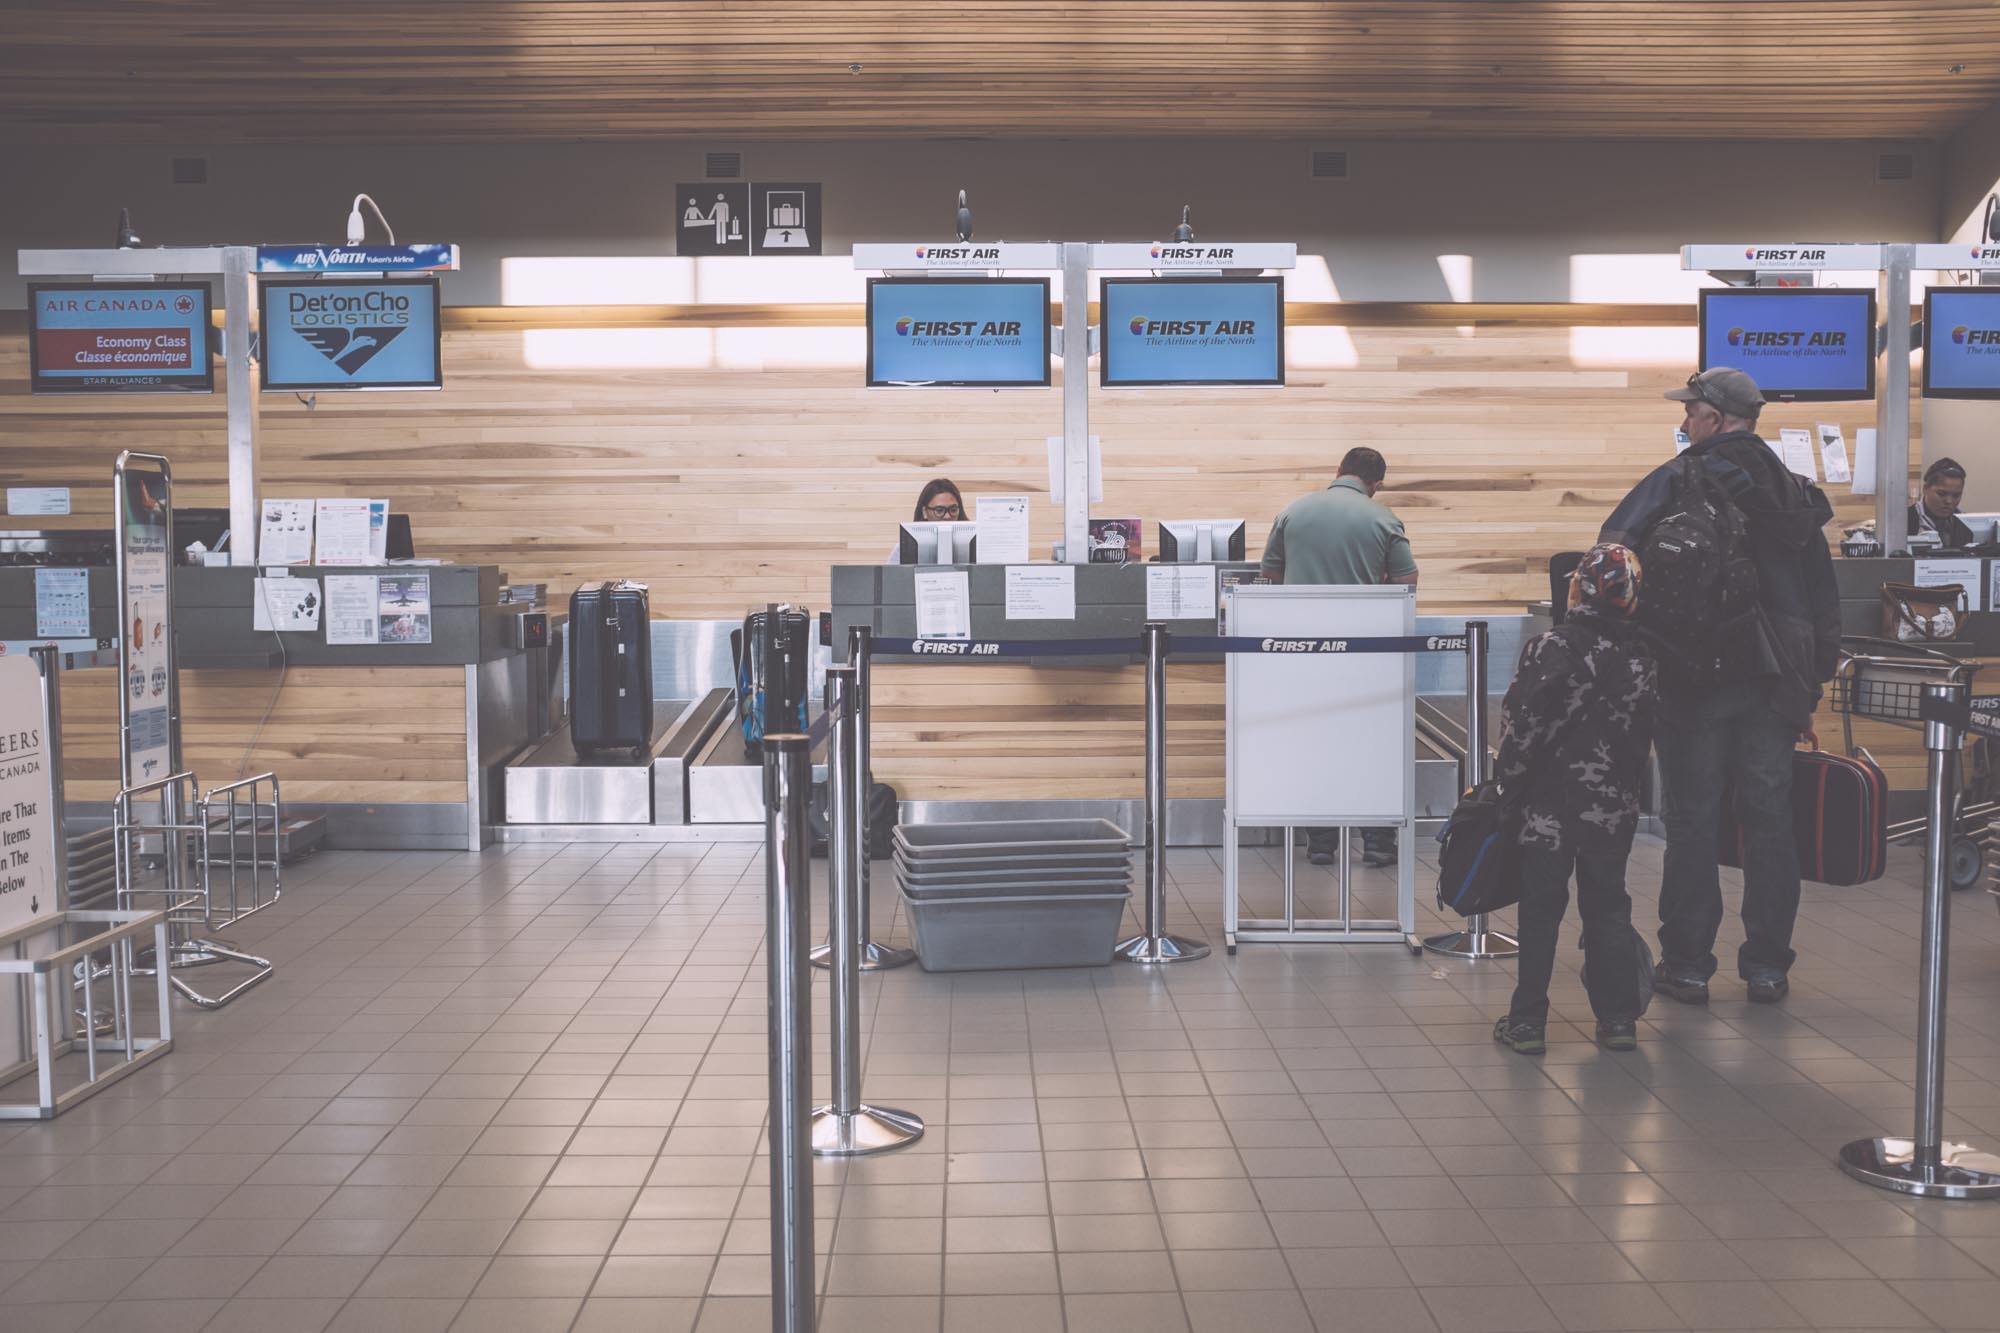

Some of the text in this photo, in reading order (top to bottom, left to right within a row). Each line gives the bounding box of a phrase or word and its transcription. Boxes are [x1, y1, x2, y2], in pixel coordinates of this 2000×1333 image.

[926, 248, 1000, 259] FIRST AIR
[1161, 248, 1234, 259] FIRST AIR
[1756, 250, 1826, 260] FIRST AIR
[46, 299, 167, 312] AIR CANADA
[364, 291, 410, 311] Cho
[290, 312, 410, 326] LOGISTICS
[912, 321, 1022, 336] FIRST AIR
[1146, 320, 1255, 336] FIRST AIR
[96, 335, 187, 351] Economy Class
[912, 337, 1022, 349] The Airline of the North
[1145, 336, 1256, 348] The Airline of the North
[1743, 331, 1847, 346] FIRST AIR
[1742, 347, 1847, 359] The Airline of the North
[1967, 345, 1983, 354] The
[75, 350, 188, 366] Classe économique
[84, 377, 155, 385] STAR ALLIANCE
[923, 642, 1000, 655] FIRST AIR
[1271, 640, 1348, 652] FIRST AIR
[13, 802, 37, 819] That
[3, 827, 31, 847] Items
[9, 849, 30, 868] The
